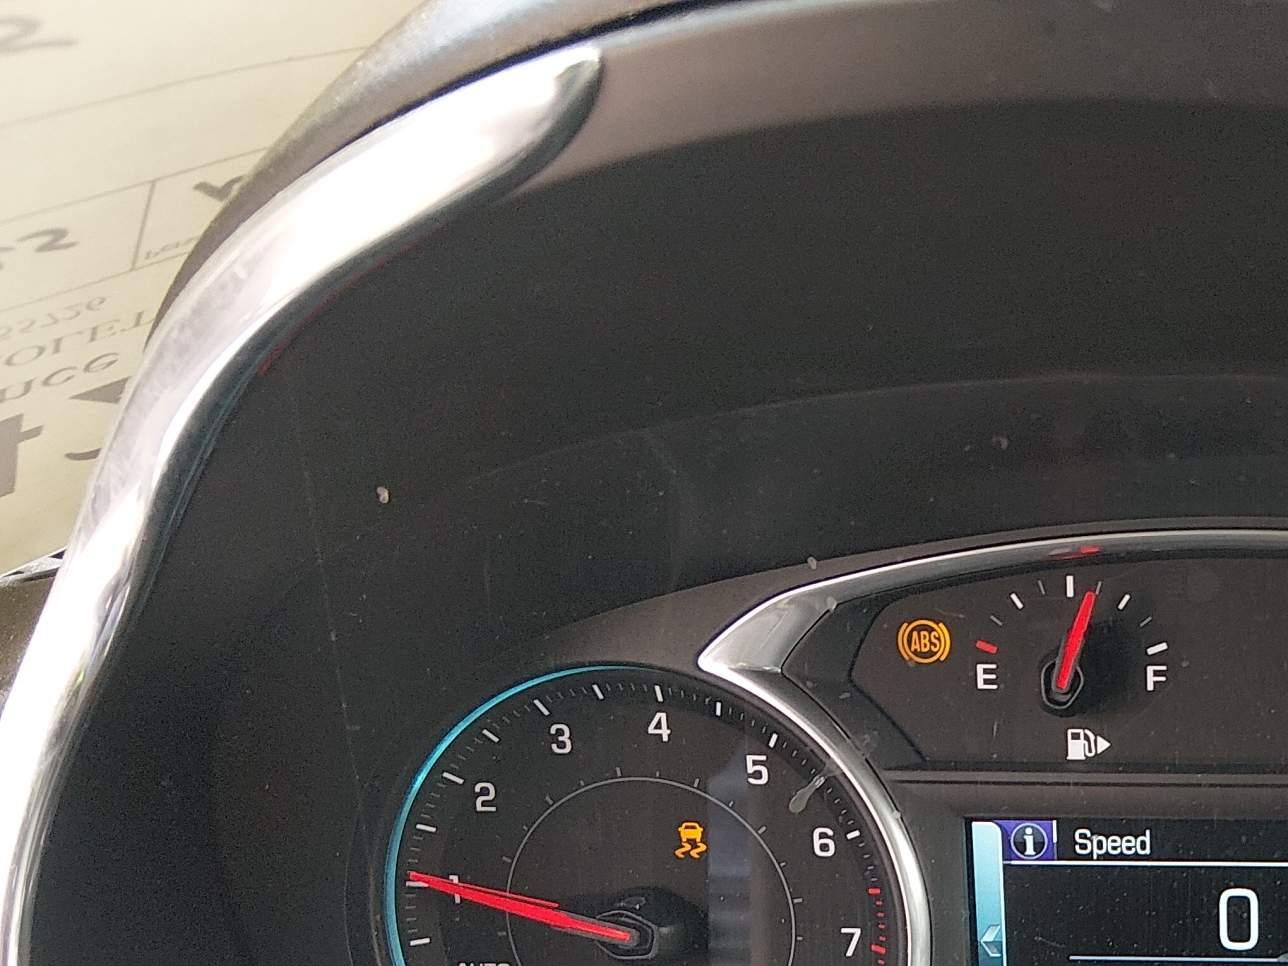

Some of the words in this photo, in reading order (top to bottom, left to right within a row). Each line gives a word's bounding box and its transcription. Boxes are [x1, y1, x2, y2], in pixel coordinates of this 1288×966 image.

[911, 631, 941, 653] ABS
[976, 664, 998, 690] E
[1146, 665, 1167, 691] F
[550, 723, 572, 754] 3
[647, 712, 671, 742] 4
[746, 754, 769, 785] 5
[474, 782, 497, 812] 2
[813, 827, 836, 857] 6
[1074, 829, 1151, 859] Speed
[1218, 887, 1259, 951] 0
[840, 927, 861, 957] 7
